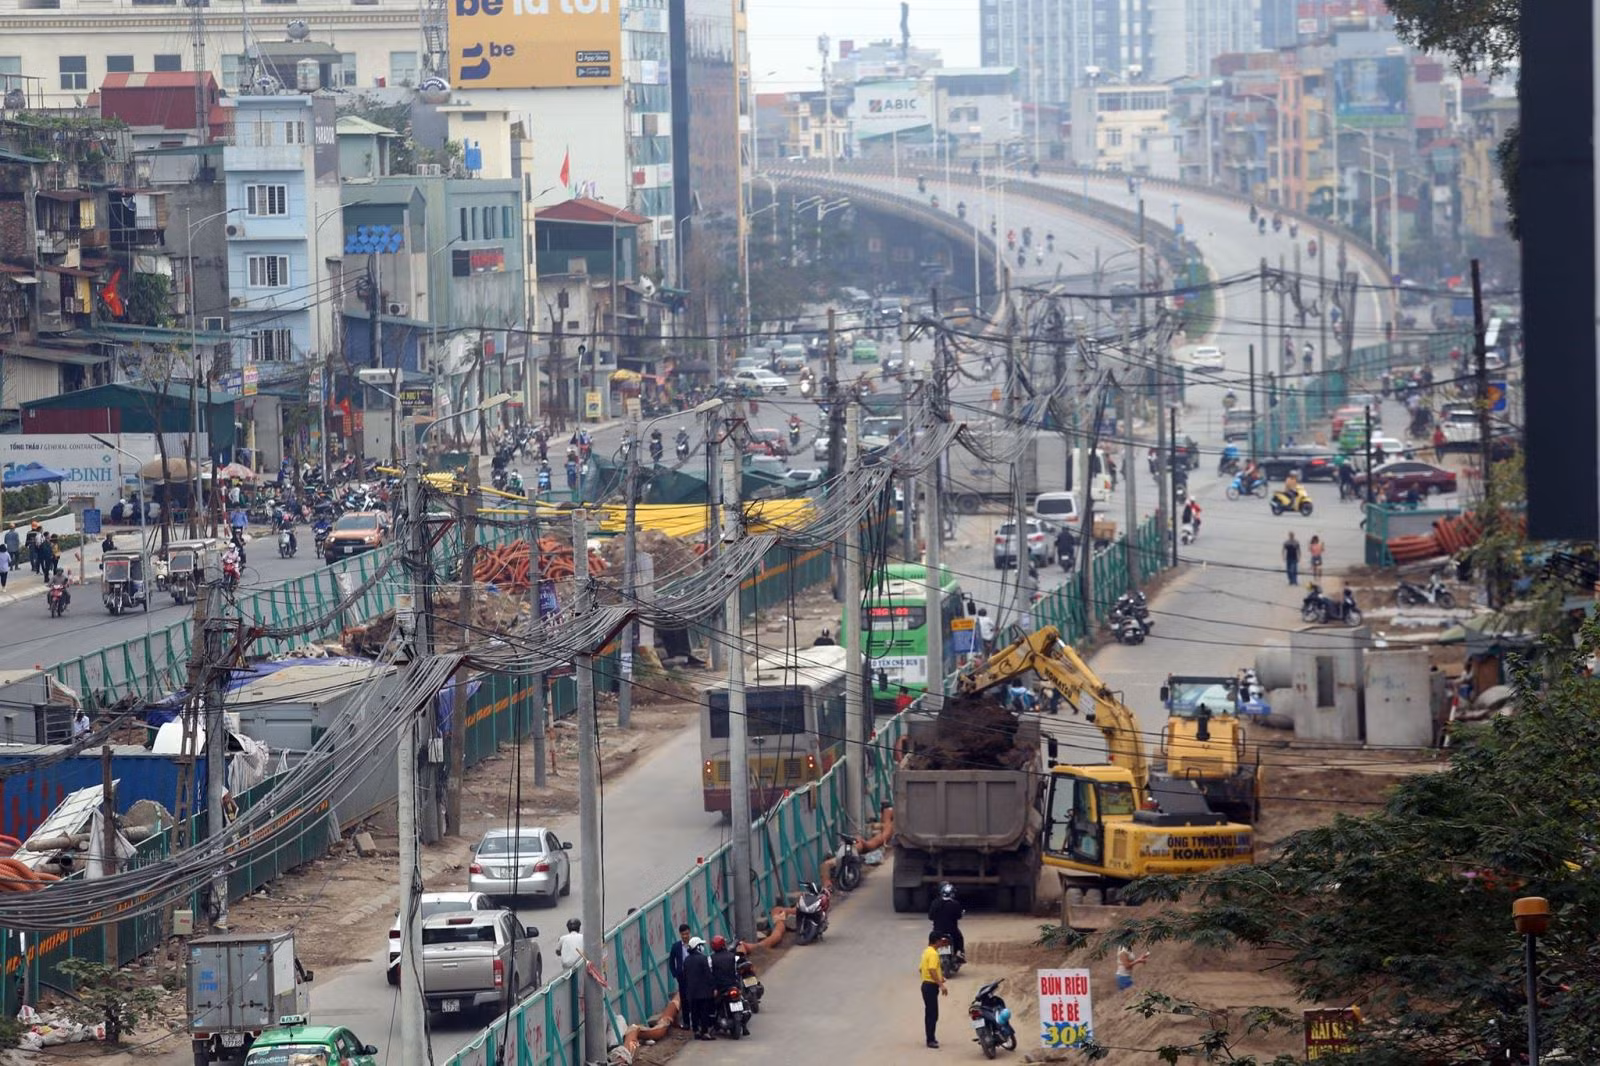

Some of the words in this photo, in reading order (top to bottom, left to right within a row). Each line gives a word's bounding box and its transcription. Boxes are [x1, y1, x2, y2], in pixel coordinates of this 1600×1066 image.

[490, 42, 515, 57] be
[884, 99, 917, 109] ABIC
[1045, 668, 1072, 698] KOMATSU
[1173, 848, 1234, 860] KOMATSU
[1041, 973, 1062, 995] BÚN
[1065, 973, 1088, 995] RIÊU
